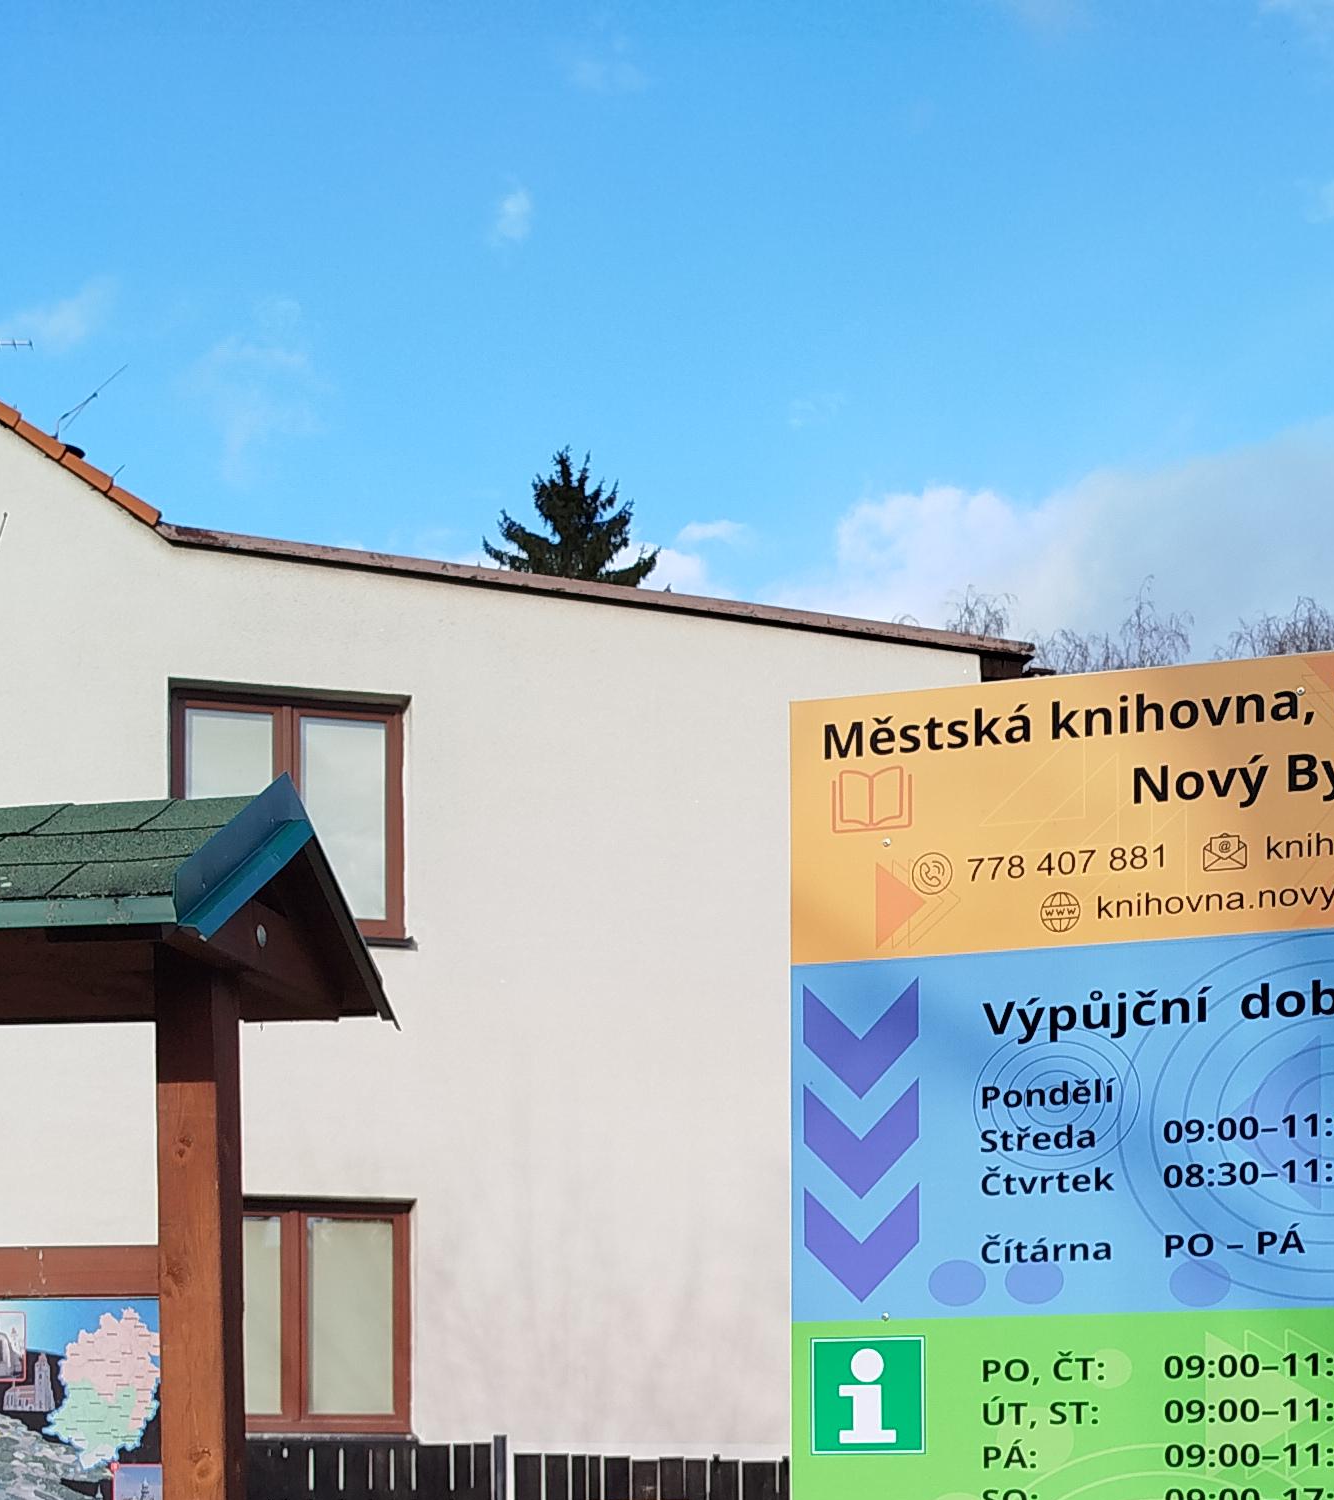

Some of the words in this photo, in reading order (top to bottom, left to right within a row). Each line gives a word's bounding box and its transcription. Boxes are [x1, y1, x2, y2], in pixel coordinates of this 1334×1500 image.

[824, 703, 1031, 760] Městská
[1051, 690, 1315, 740] knihovna,
[1133, 754, 1269, 809] Nový
[967, 855, 1025, 882] 778
[1036, 849, 1096, 876] 407
[1109, 843, 1164, 872] 881
[1044, 907, 1077, 917] www
[982, 986, 1212, 1045] Výpůjční
[982, 1078, 1113, 1109] Pondělí
[980, 1119, 1096, 1153] Středa
[981, 1164, 1114, 1196] Čtvrtek
[981, 1234, 1111, 1264] Čítárna
[1165, 1233, 1214, 1258] PO
[1257, 1223, 1305, 1255] PÁ
[982, 1358, 1040, 1386] PO,
[1053, 1351, 1104, 1381] ČT:
[983, 1394, 1036, 1429] ÚT,
[1049, 1401, 1099, 1425] ST:
[983, 1439, 1037, 1469] PÁ:
